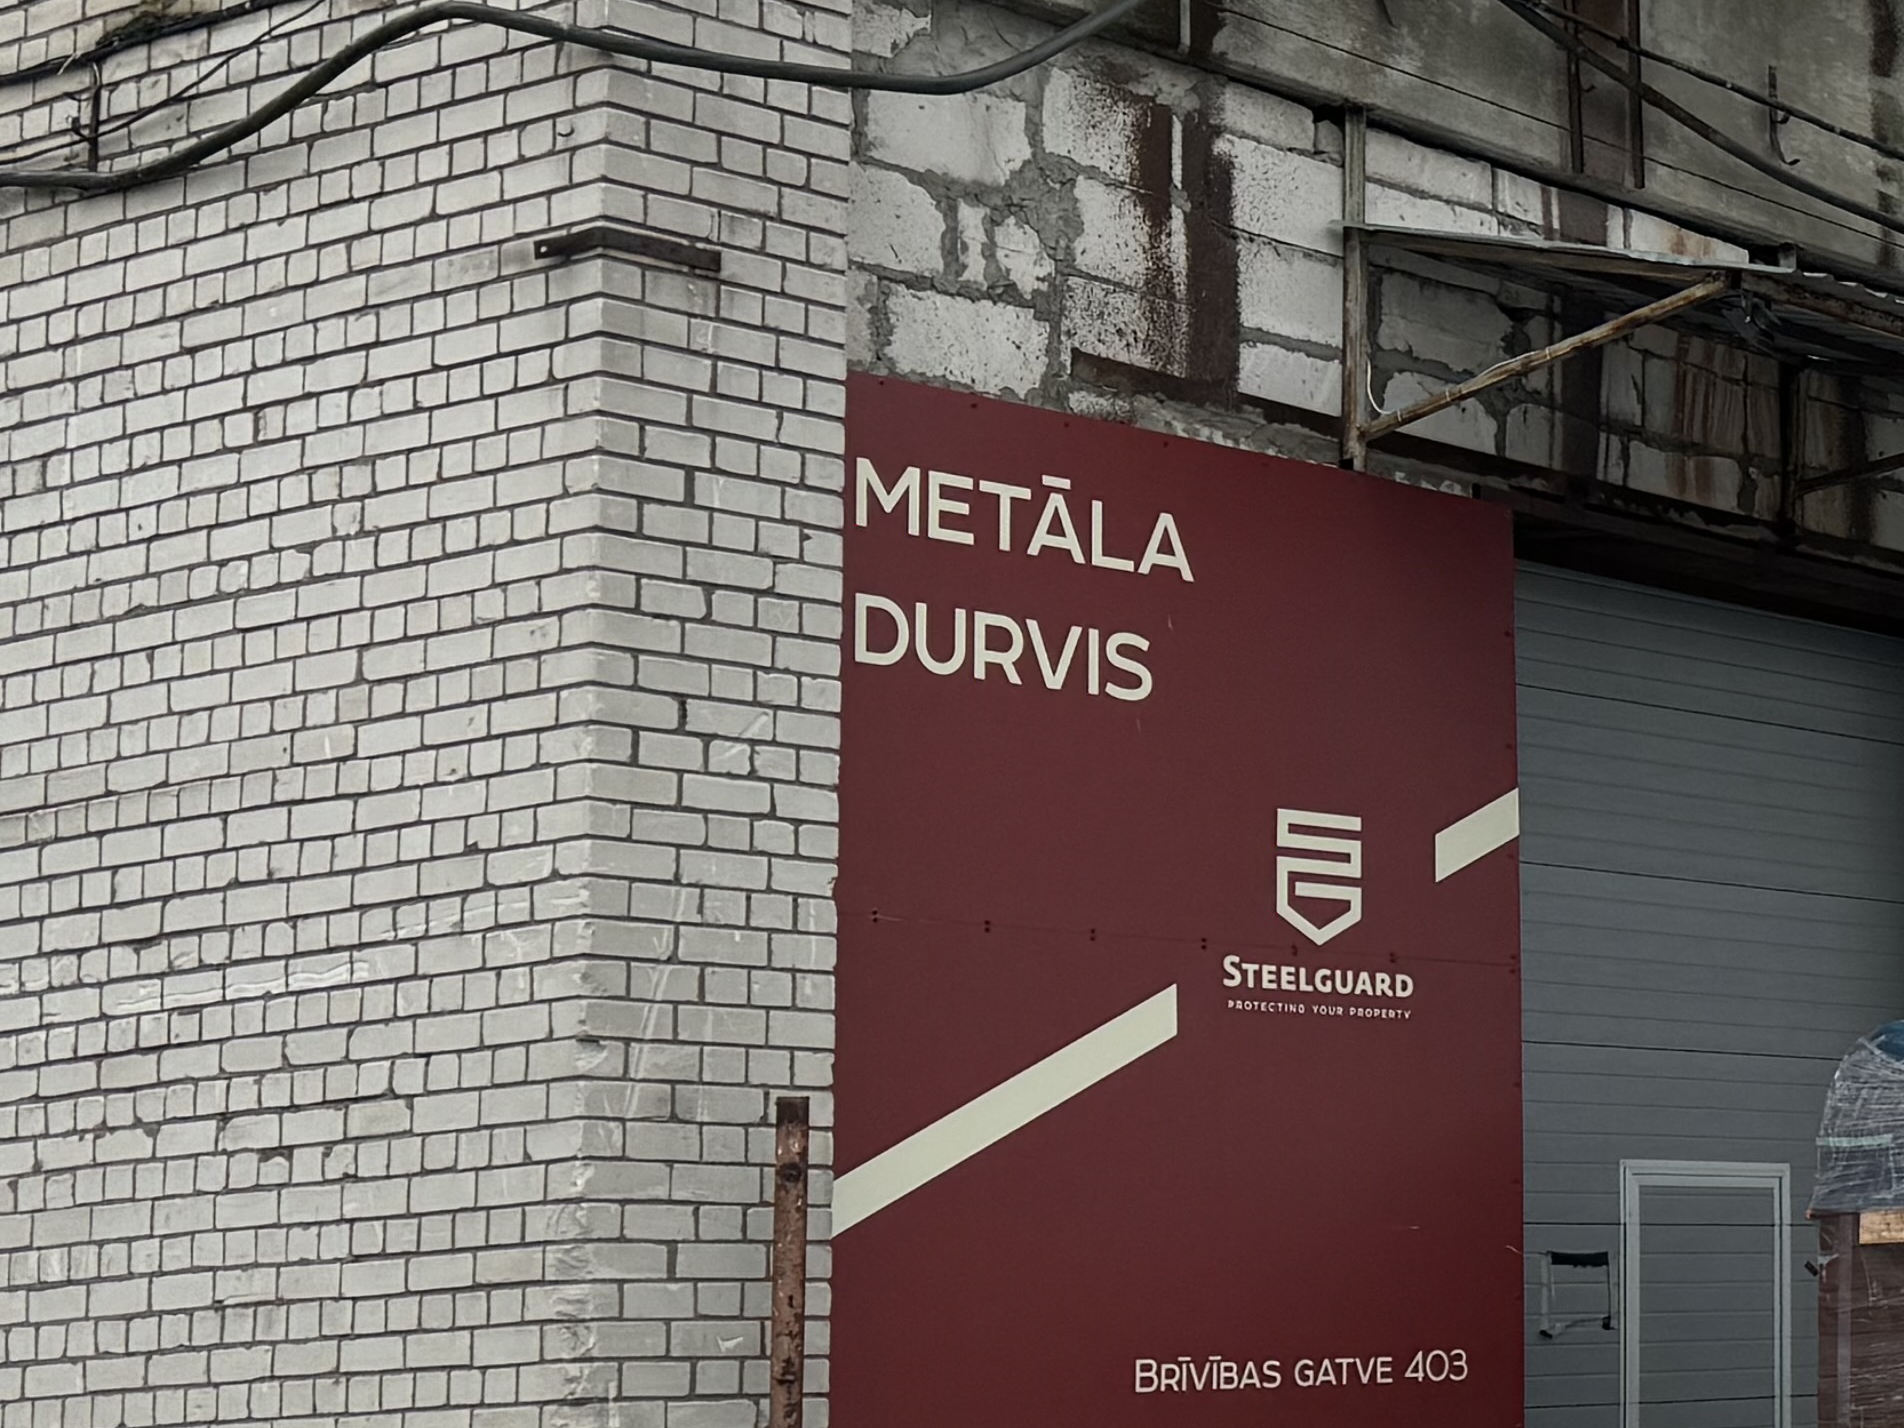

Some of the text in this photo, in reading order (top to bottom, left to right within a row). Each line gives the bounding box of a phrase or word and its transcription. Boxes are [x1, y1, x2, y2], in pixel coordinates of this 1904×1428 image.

[854, 456, 1195, 583] METĀLA
[854, 592, 1154, 701] DURVIS
[1222, 954, 1415, 998] STEELGUARD
[1312, 1004, 1344, 1017] YOUR
[1349, 1006, 1412, 1020] PROPERTY
[1134, 1349, 1469, 1393] BRĪVĪBAS GATVE 403
